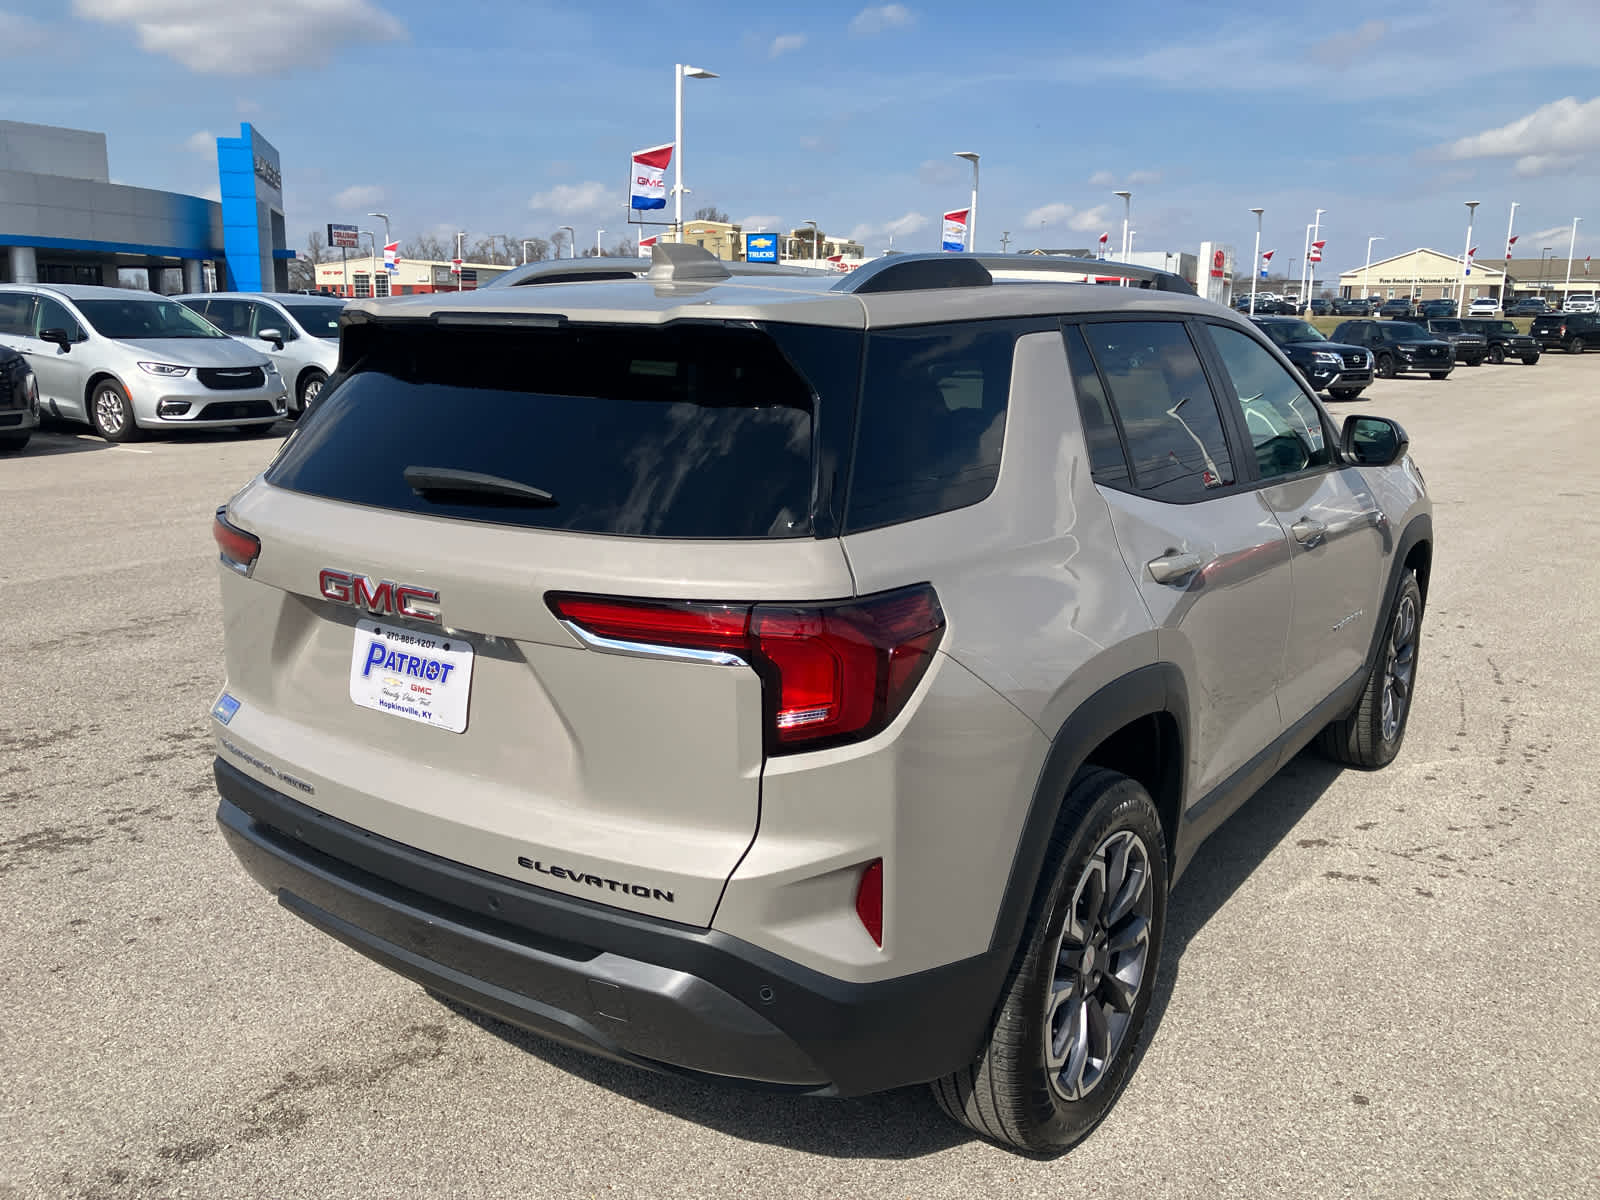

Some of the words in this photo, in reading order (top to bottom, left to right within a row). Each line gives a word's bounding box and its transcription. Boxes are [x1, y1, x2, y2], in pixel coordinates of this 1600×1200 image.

[637, 176, 664, 187] GMC
[333, 231, 358, 239] COLLISION
[319, 567, 442, 624] GMC
[386, 631, 436, 649] 270-886-1207
[362, 641, 455, 684] PATRIOT
[410, 684, 433, 696] GMC
[379, 699, 421, 718] Hopkinsville,
[422, 709, 433, 720] KY
[517, 856, 675, 903] ELEVATION
